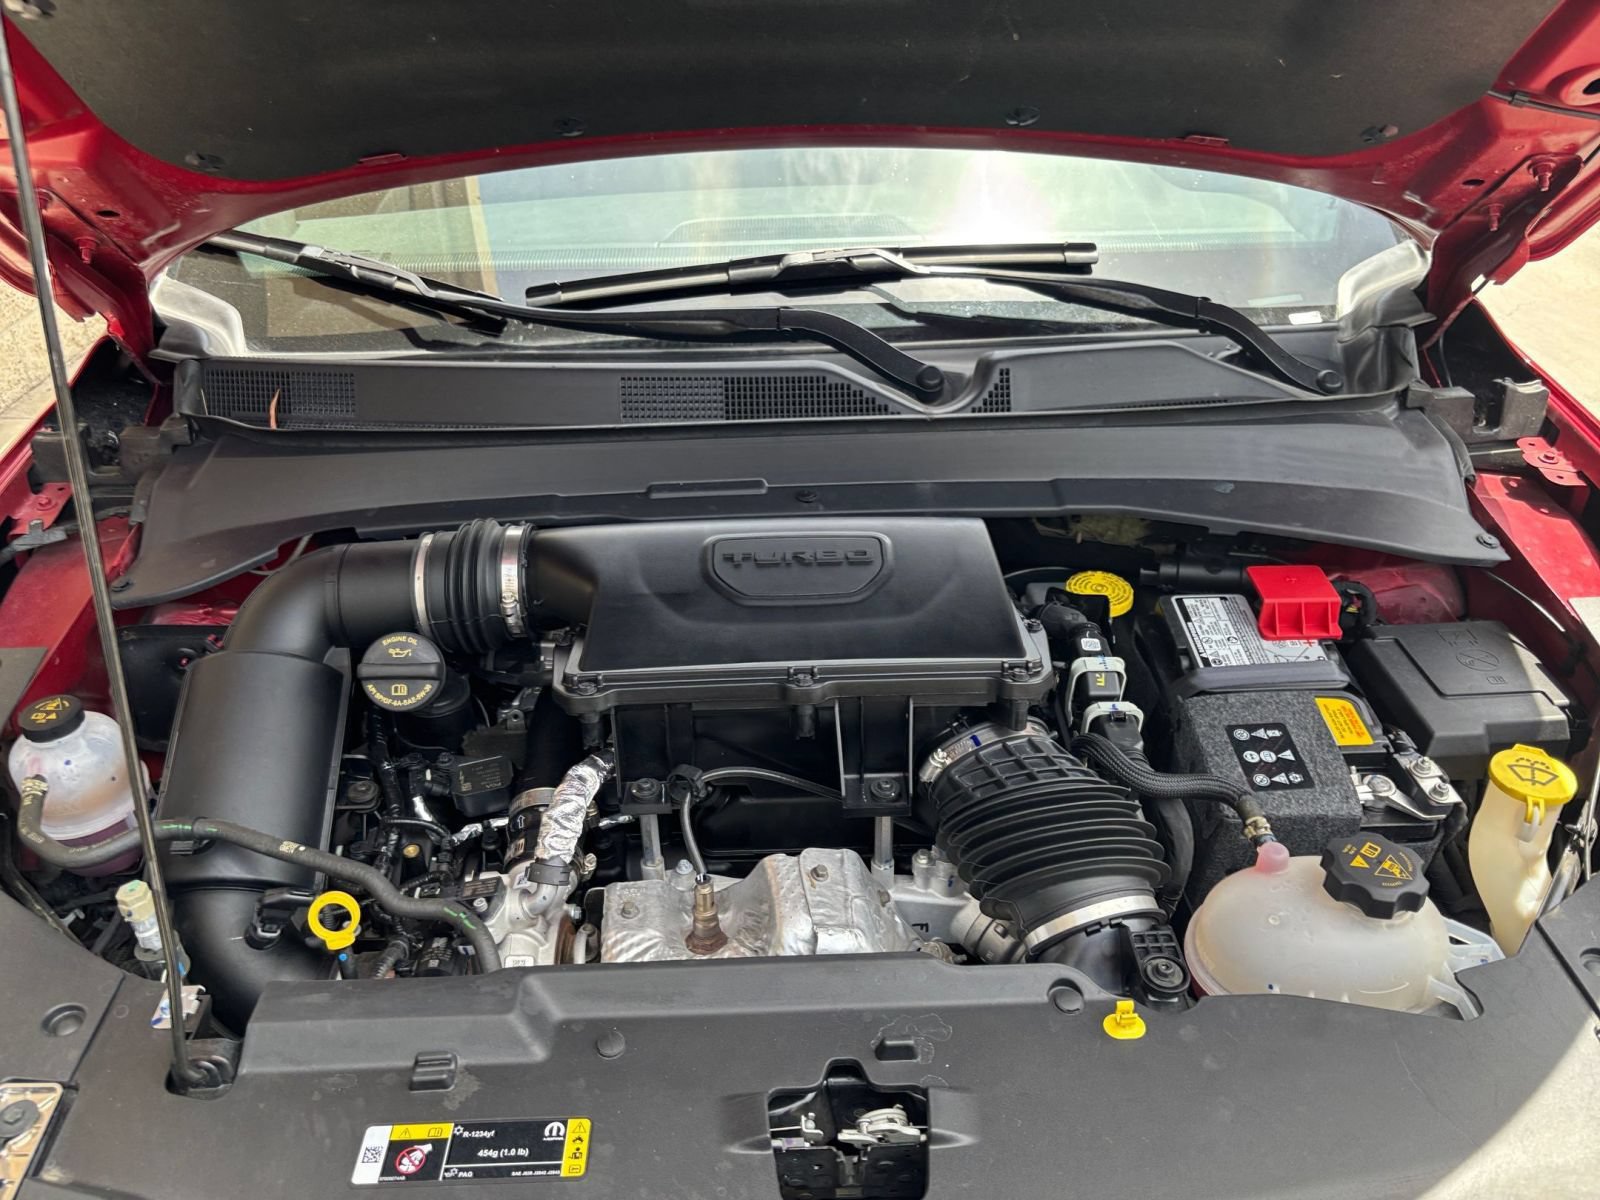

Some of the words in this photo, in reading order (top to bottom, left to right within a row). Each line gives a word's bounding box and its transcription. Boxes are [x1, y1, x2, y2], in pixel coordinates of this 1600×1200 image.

[722, 550, 873, 568] TURBO
[382, 636, 406, 646] ENGINE
[407, 637, 418, 646] OIL
[463, 1130, 495, 1139] R-1234yf
[477, 1149, 498, 1158] 454g
[500, 1149, 516, 1158] (1.0
[517, 1148, 529, 1157] lb)
